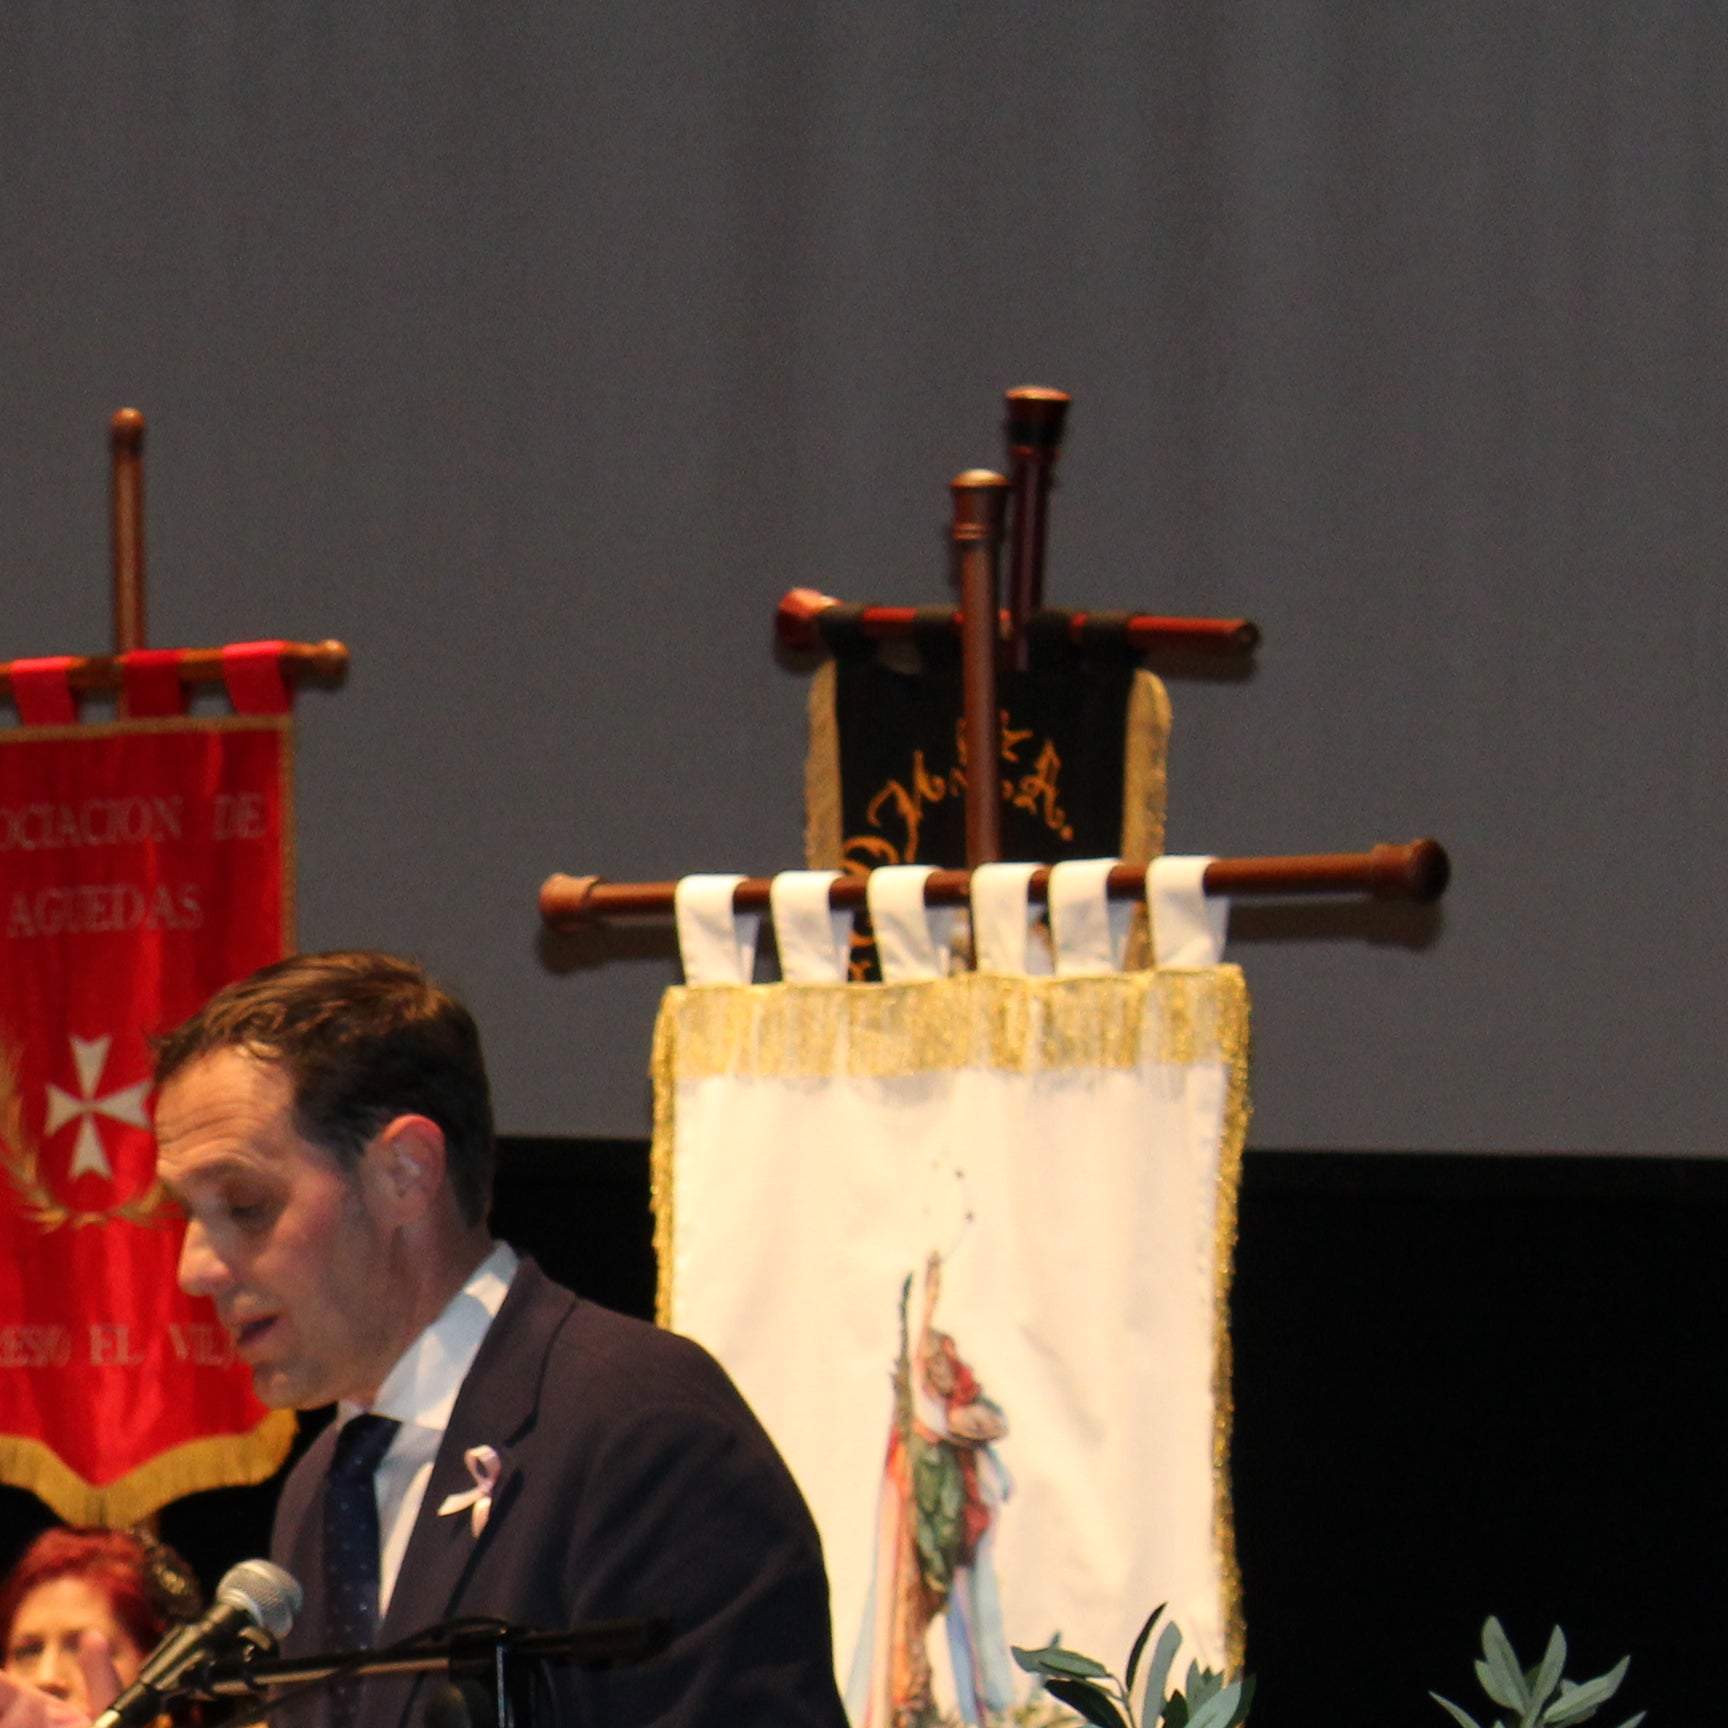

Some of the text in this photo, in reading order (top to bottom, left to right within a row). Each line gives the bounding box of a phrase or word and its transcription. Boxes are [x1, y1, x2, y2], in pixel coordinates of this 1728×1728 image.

[212, 791, 266, 841] DE
[6, 882, 205, 938] AGUEDAS
[89, 1322, 147, 1368] EL
